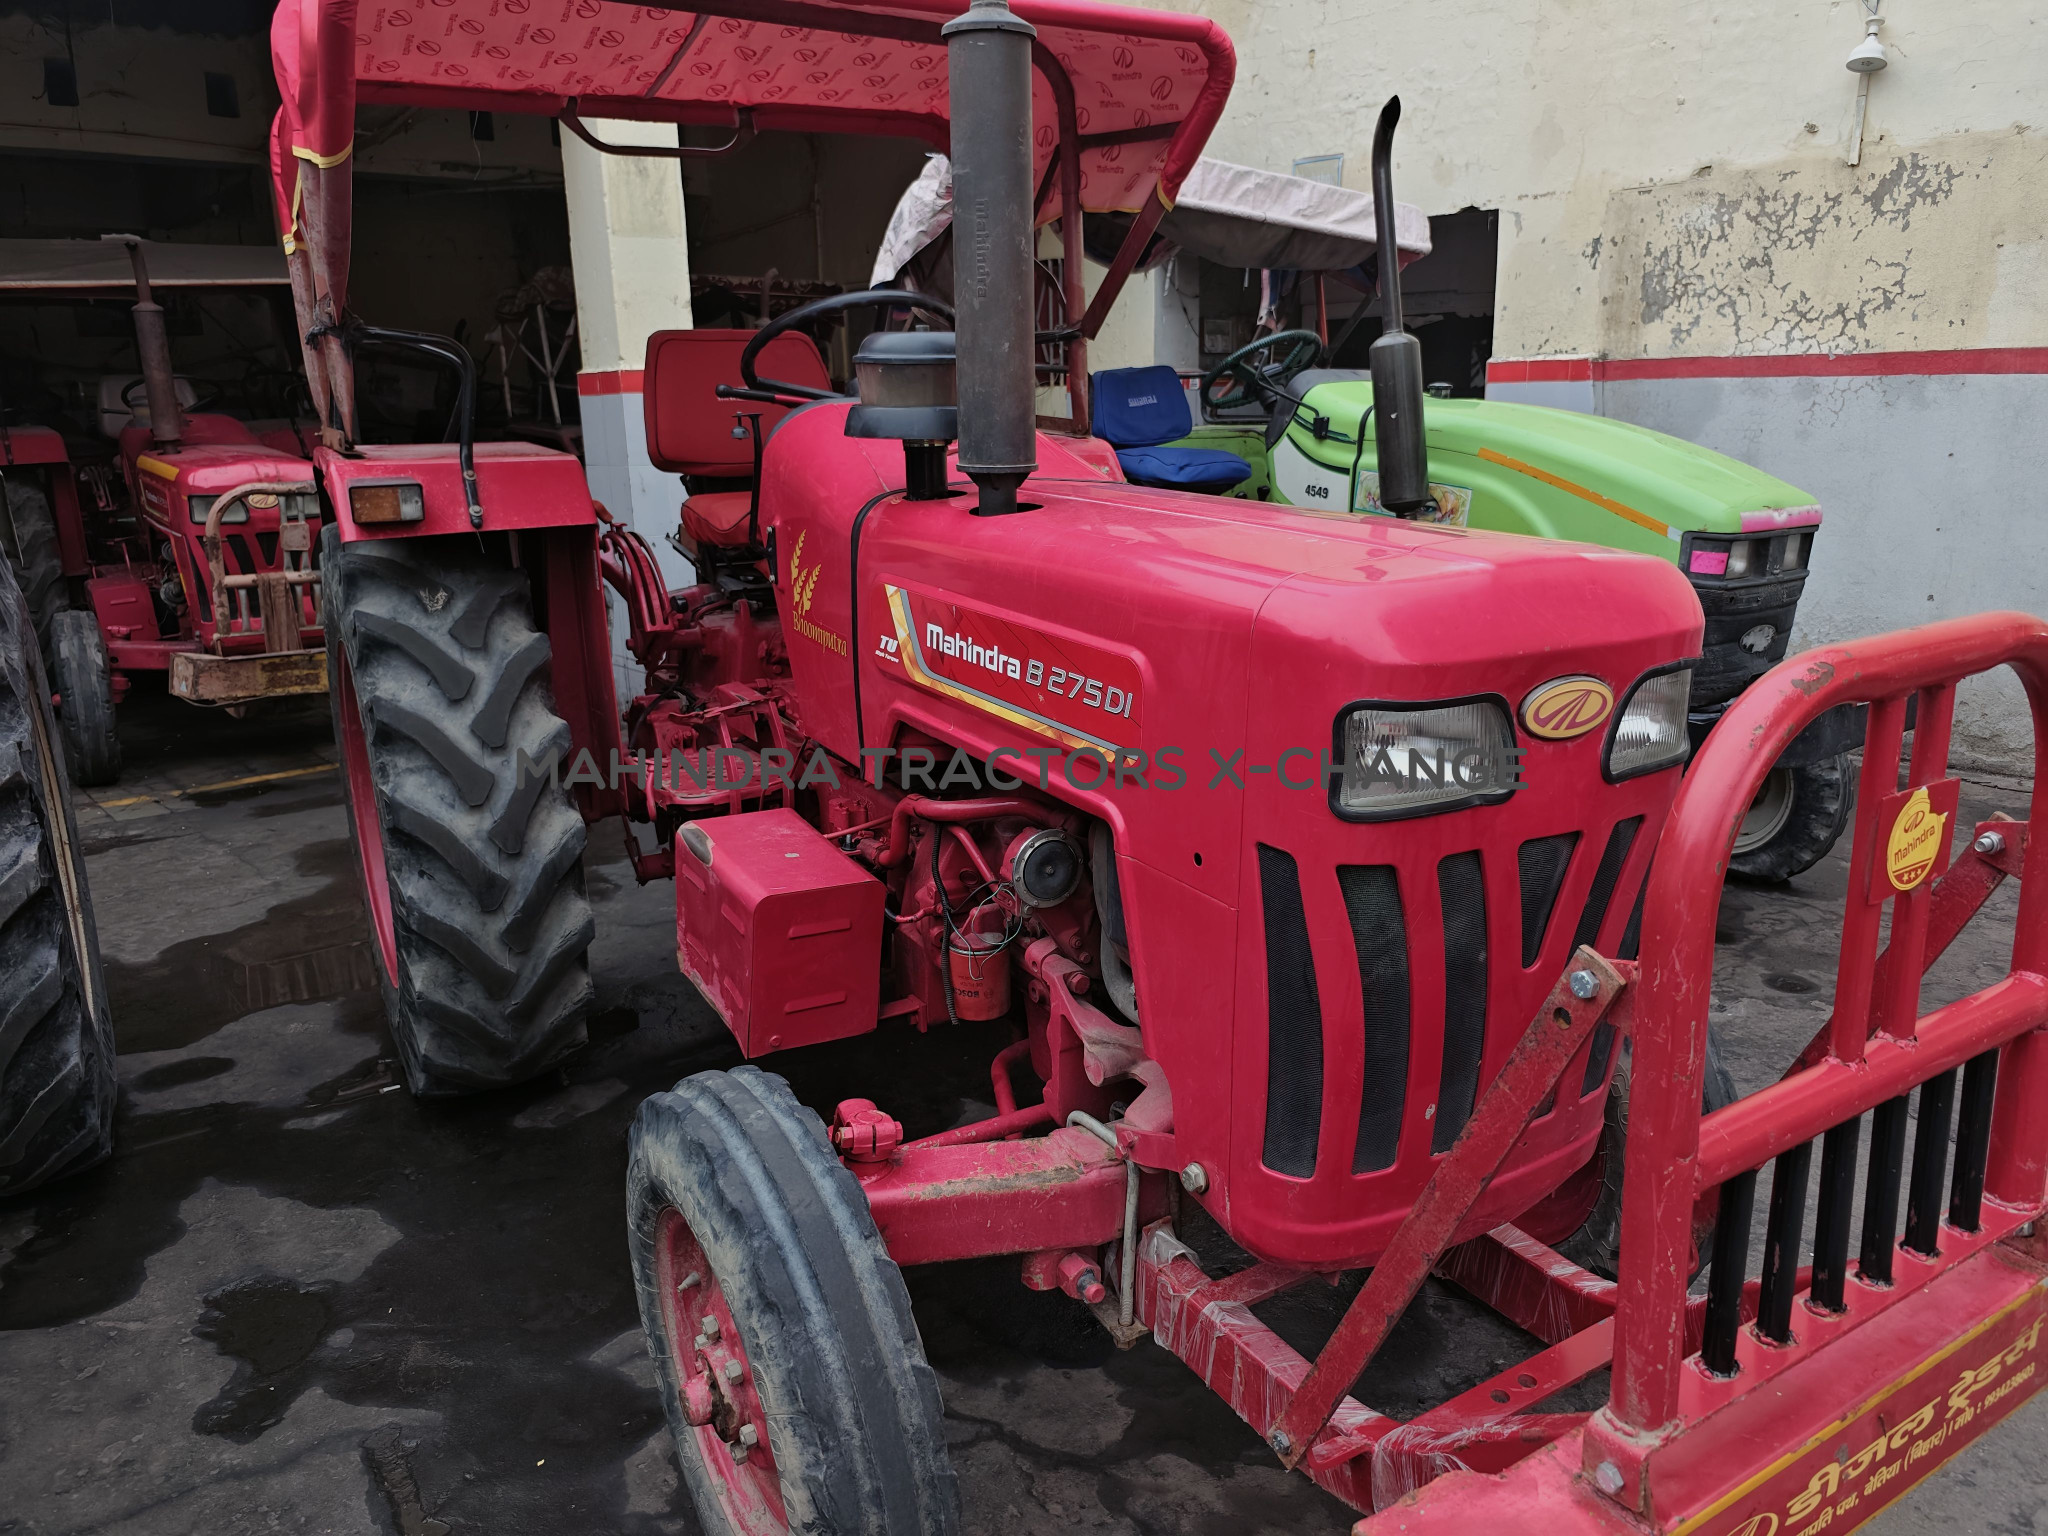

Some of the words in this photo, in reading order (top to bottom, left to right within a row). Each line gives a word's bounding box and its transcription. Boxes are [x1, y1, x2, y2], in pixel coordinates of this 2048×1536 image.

[1304, 484, 1329, 499] 4549
[926, 622, 1021, 680] Mahindra
[1894, 825, 1936, 866] Mahindra
[955, 988, 980, 998] BOSC
[1785, 1396, 1941, 1526] डीजल
